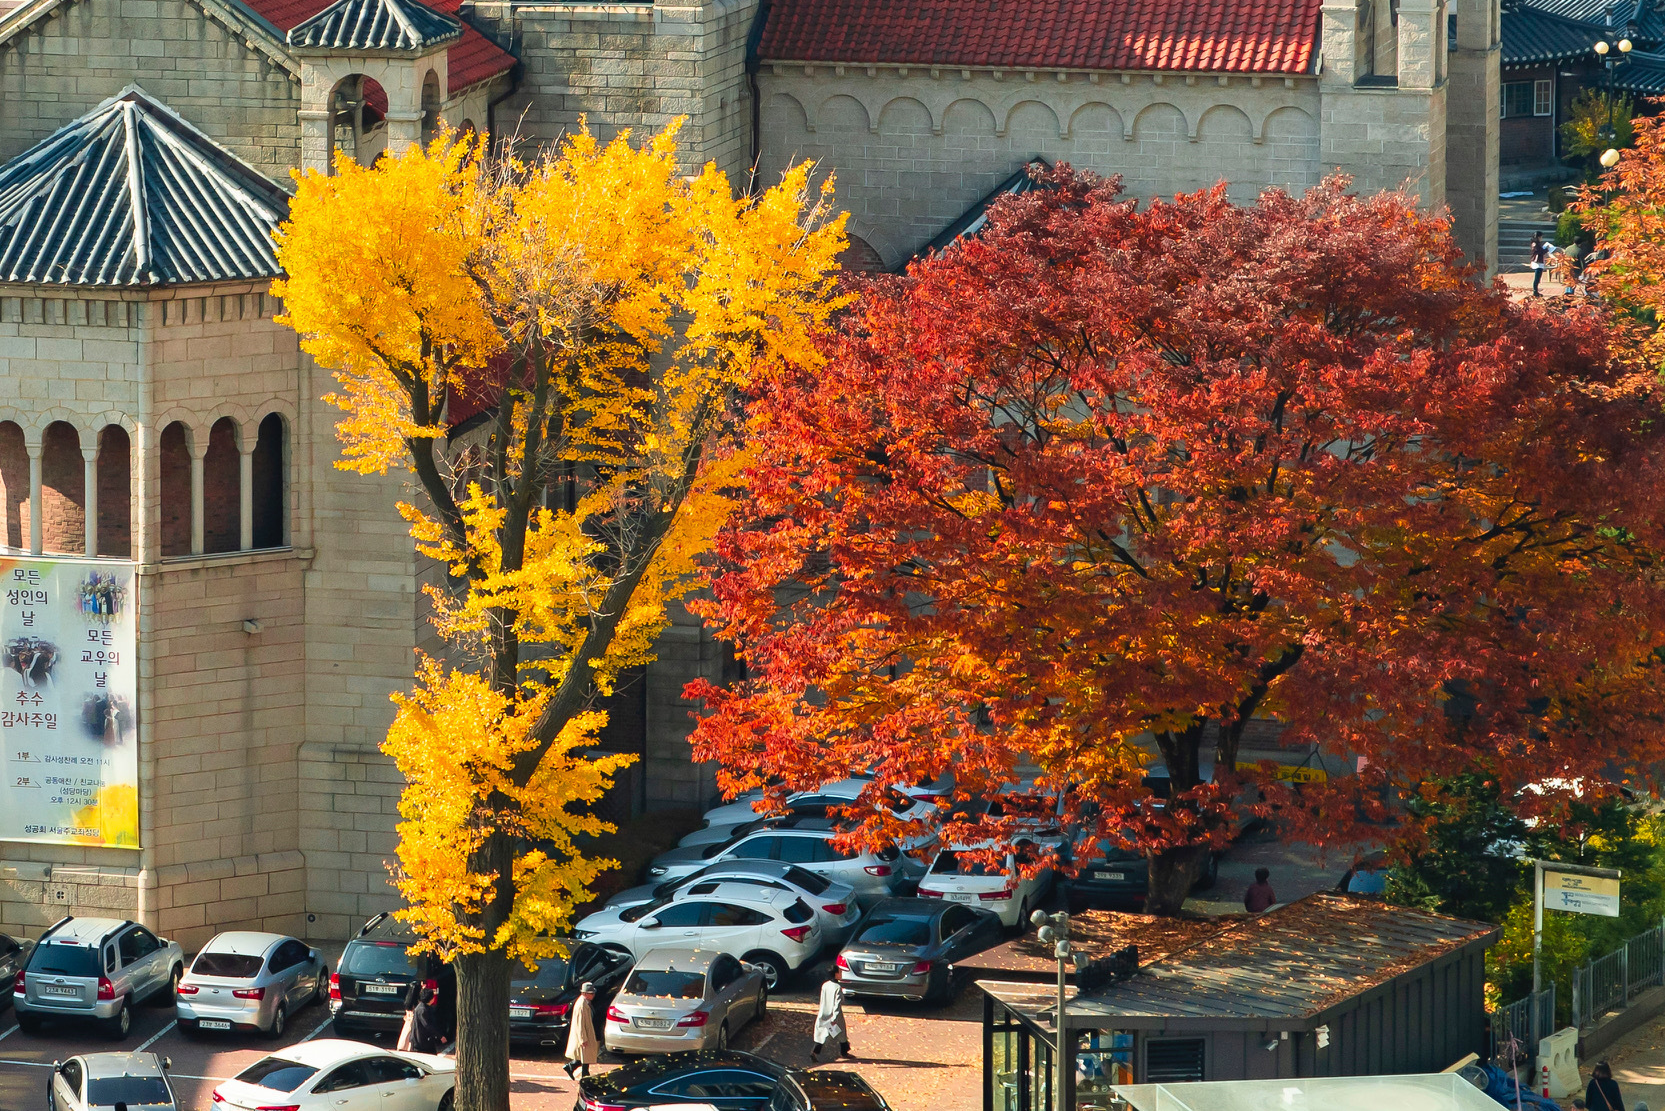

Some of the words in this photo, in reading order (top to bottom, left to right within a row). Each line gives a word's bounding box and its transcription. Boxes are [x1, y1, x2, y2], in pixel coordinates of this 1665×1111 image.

[13, 569, 40, 586] 모든
[7, 589, 48, 606] 성인의
[22, 610, 35, 627] 날
[87, 629, 113, 646] 모든
[81, 650, 120, 666] 교우의
[95, 671, 107, 688] 날
[16, 690, 44, 706] 추수
[1, 711, 57, 730] 감사주일
[17, 752, 29, 760] 1부
[80, 757, 94, 765] 오전
[96, 758, 110, 766] 11시
[17, 777, 30, 785] 2부
[50, 796, 63, 804] 오후
[66, 797, 82, 805] 12시
[24, 825, 46, 834] 성공회
